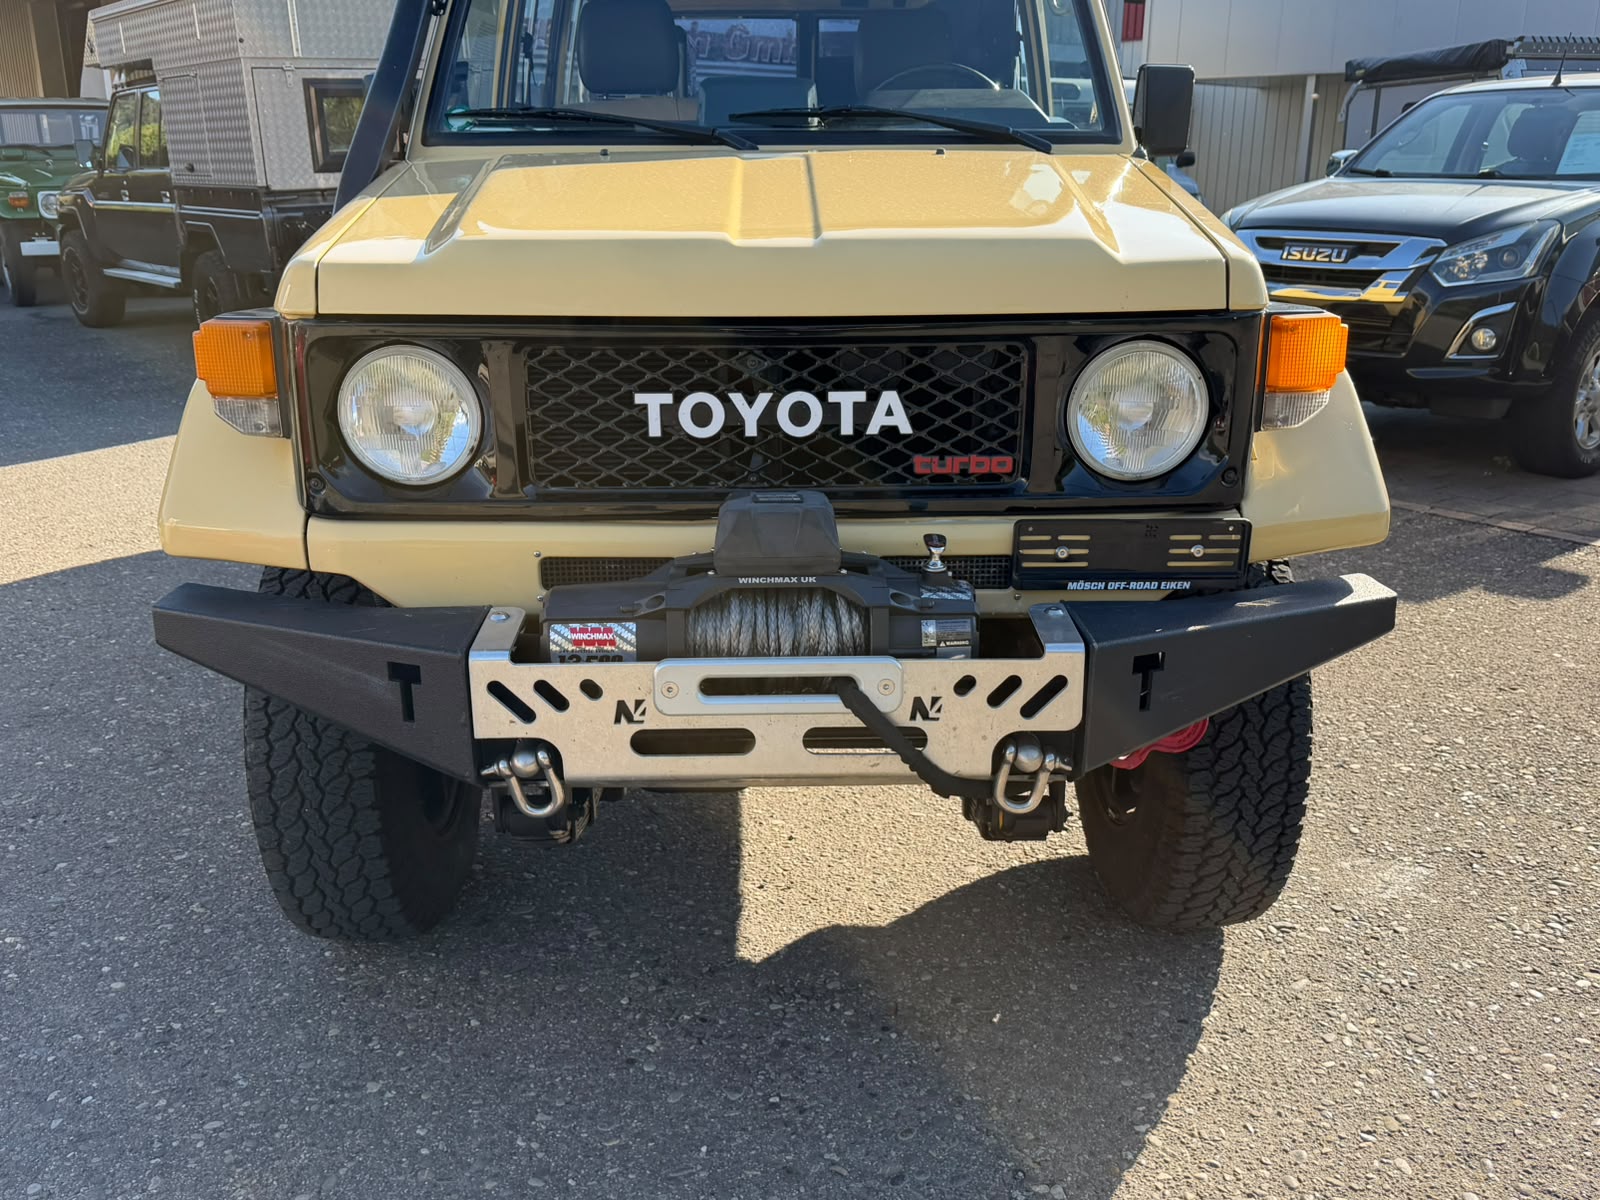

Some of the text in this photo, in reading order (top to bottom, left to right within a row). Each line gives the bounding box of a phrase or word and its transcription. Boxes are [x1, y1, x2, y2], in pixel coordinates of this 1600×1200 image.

[1282, 246, 1348, 262] ISUZU
[634, 391, 913, 438] TOYOTA
[913, 455, 1013, 474] turbo
[738, 576, 798, 584] WINCHMAX
[1067, 580, 1191, 590] MÖSCH OFF-ROAD EIKEN
[571, 632, 615, 640] WINCHMAX
